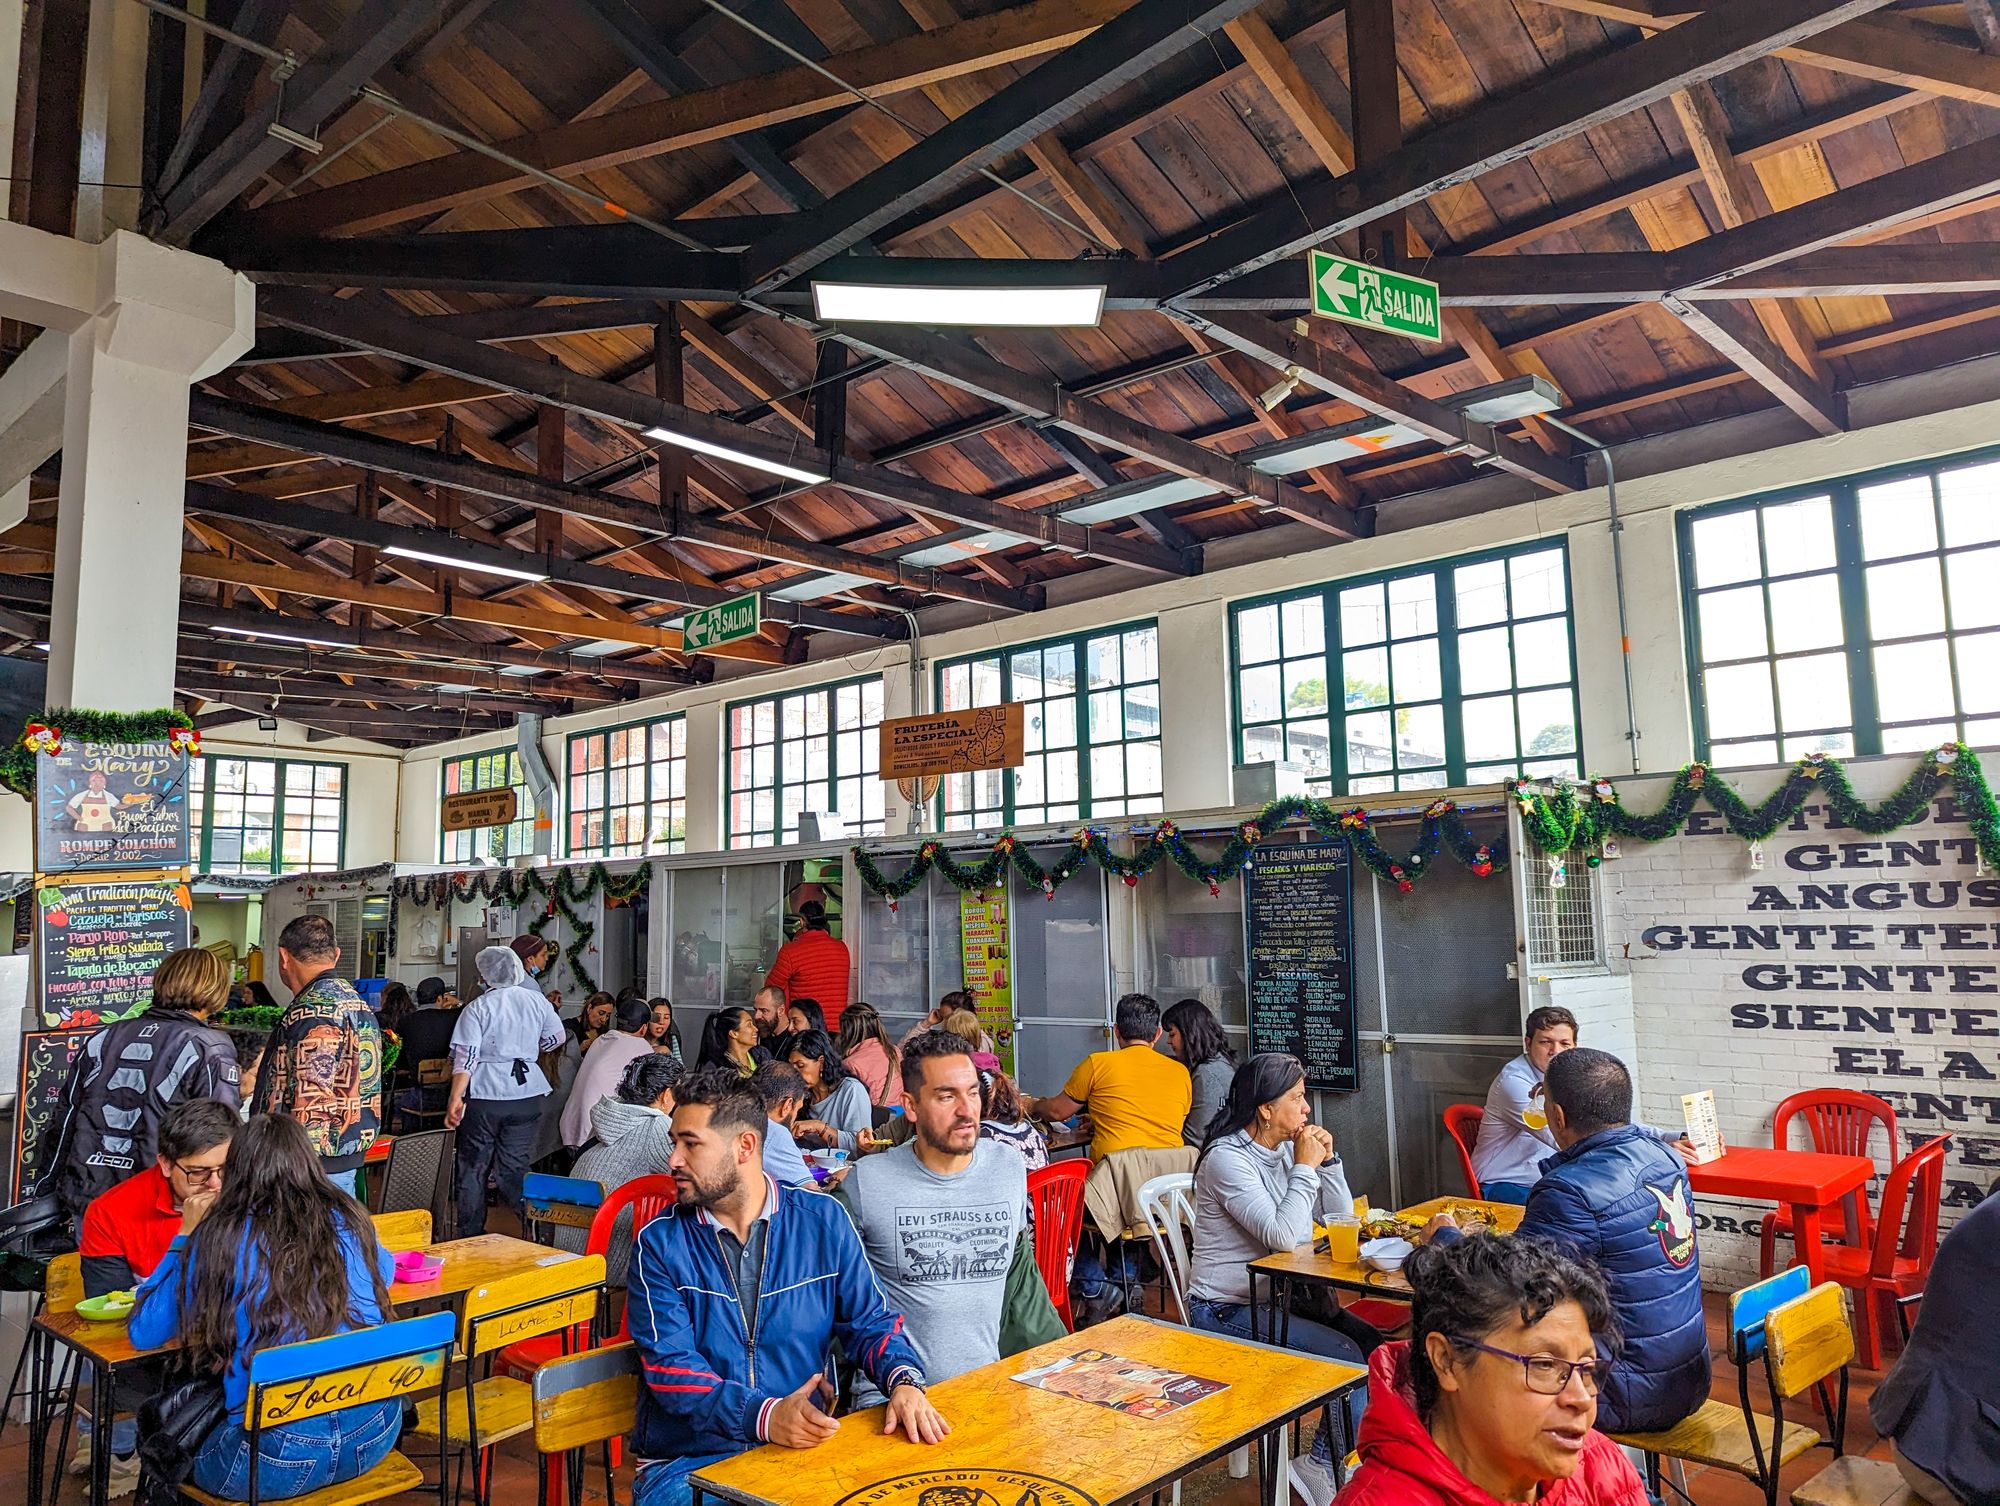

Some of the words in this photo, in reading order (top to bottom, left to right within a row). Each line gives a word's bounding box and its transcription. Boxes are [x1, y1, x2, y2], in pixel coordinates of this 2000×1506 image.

[1384, 286, 1435, 327] SALIDA
[722, 605, 753, 633] SALIDA
[894, 719, 960, 735] FRUTERÍA
[894, 736, 911, 745] LA
[912, 728, 976, 743] ESPECIAL
[56, 757, 72, 766] DE
[81, 757, 170, 787] Mary
[140, 800, 154, 814] El
[60, 839, 114, 853] ROMPE
[117, 835, 176, 850] COLCHÓN
[114, 851, 142, 861] 2002
[1255, 852, 1266, 862] LA
[1269, 849, 1306, 861] ESQUINA
[1308, 849, 1318, 858] DE
[1320, 848, 1342, 858] MARY
[1259, 865, 1290, 874] PESCADOS
[1300, 863, 1336, 871] MARISCOS
[79, 885, 139, 902] tradición
[66, 906, 96, 914] PACIFIC
[99, 904, 136, 912] TRADITION
[69, 912, 113, 926] Cazuela
[123, 910, 168, 922] Mariscos
[67, 931, 101, 945] Pargo
[101, 931, 129, 944] Rojo
[1641, 924, 1875, 951] GENTE
[1886, 922, 2000, 950] TE
[66, 947, 95, 958] Sierra
[98, 943, 120, 955] Frita
[121, 945, 127, 954] o
[128, 940, 164, 953] Sudada
[64, 963, 102, 977] Tapado
[103, 962, 117, 973] de
[1276, 972, 1320, 981] PESCADOS
[48, 981, 86, 993] Encocado
[91, 980, 107, 989] con
[108, 977, 128, 988] Tollo
[1742, 965, 1999, 993] GENTE
[1306, 1016, 1331, 1024] ROBALO
[1730, 1003, 2000, 1037] SIENTE
[1308, 1052, 1339, 1061] SALMÓN
[1833, 1046, 1924, 1077] EL
[1307, 1066, 1326, 1074] FILETE
[1330, 1067, 1354, 1075] PESCADO
[86, 1153, 134, 1169] icon
[898, 1216, 925, 1226] LEVI
[930, 1211, 982, 1225] STRAUSS
[985, 1213, 993, 1223] &
[995, 1211, 1011, 1221] CO.
[905, 1231, 957, 1242] ORIGINAL
[961, 1229, 1007, 1240] RIVETED
[919, 1241, 944, 1249] QUALITY
[970, 1238, 998, 1246] CLOTHING
[267, 1363, 379, 1419] Local
[388, 1364, 425, 1393] 40
[873, 1488, 893, 1501] DE
[892, 1473, 980, 1491] MERCADO
[996, 1475, 1049, 1495] DESDE
